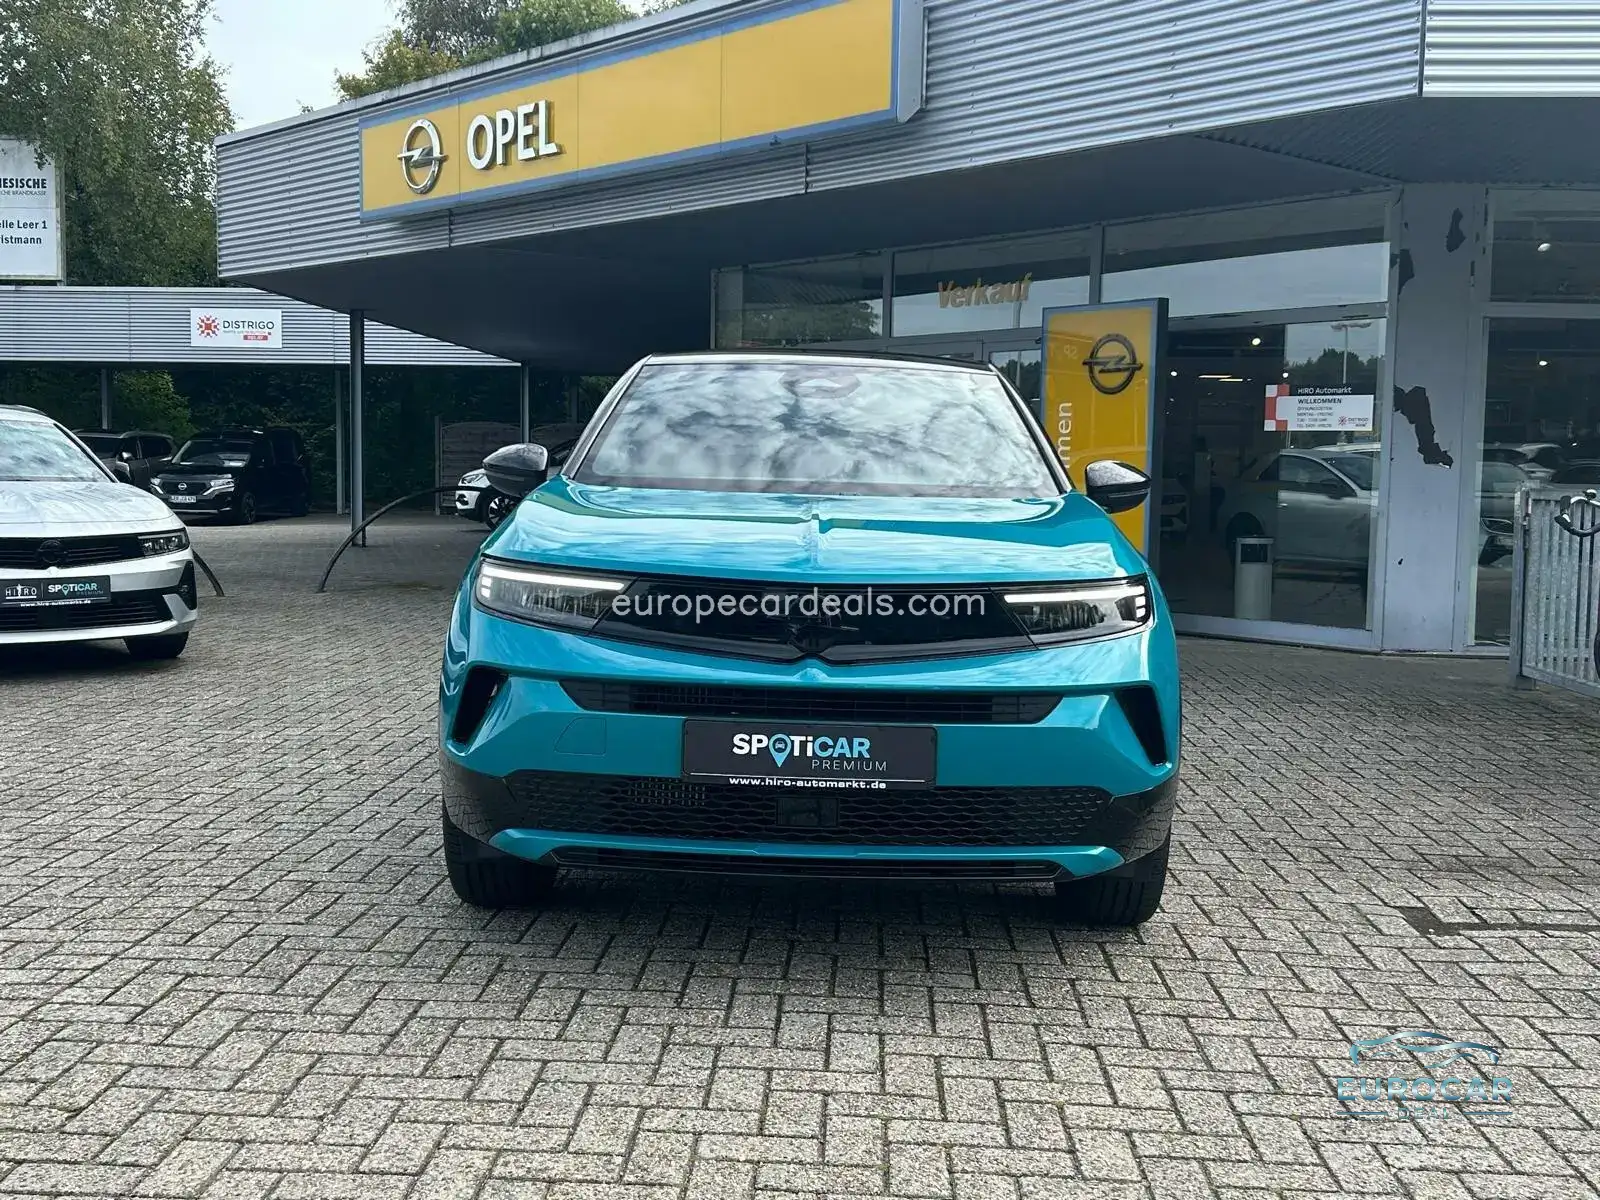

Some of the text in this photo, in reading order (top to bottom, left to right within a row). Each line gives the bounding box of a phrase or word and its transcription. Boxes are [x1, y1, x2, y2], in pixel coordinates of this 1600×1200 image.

[467, 100, 558, 170] OPEL
[17, 219, 39, 229] Leer
[41, 220, 48, 229] 1
[938, 272, 1032, 308] Verkauf
[223, 320, 275, 330] DISTRIGO
[1315, 386, 1352, 394] Automarkt
[1057, 402, 1073, 469] men
[5, 588, 37, 596] HIRO
[811, 759, 888, 772] PREMIUM
[729, 777, 887, 790] www.hiro-automarkt.de
